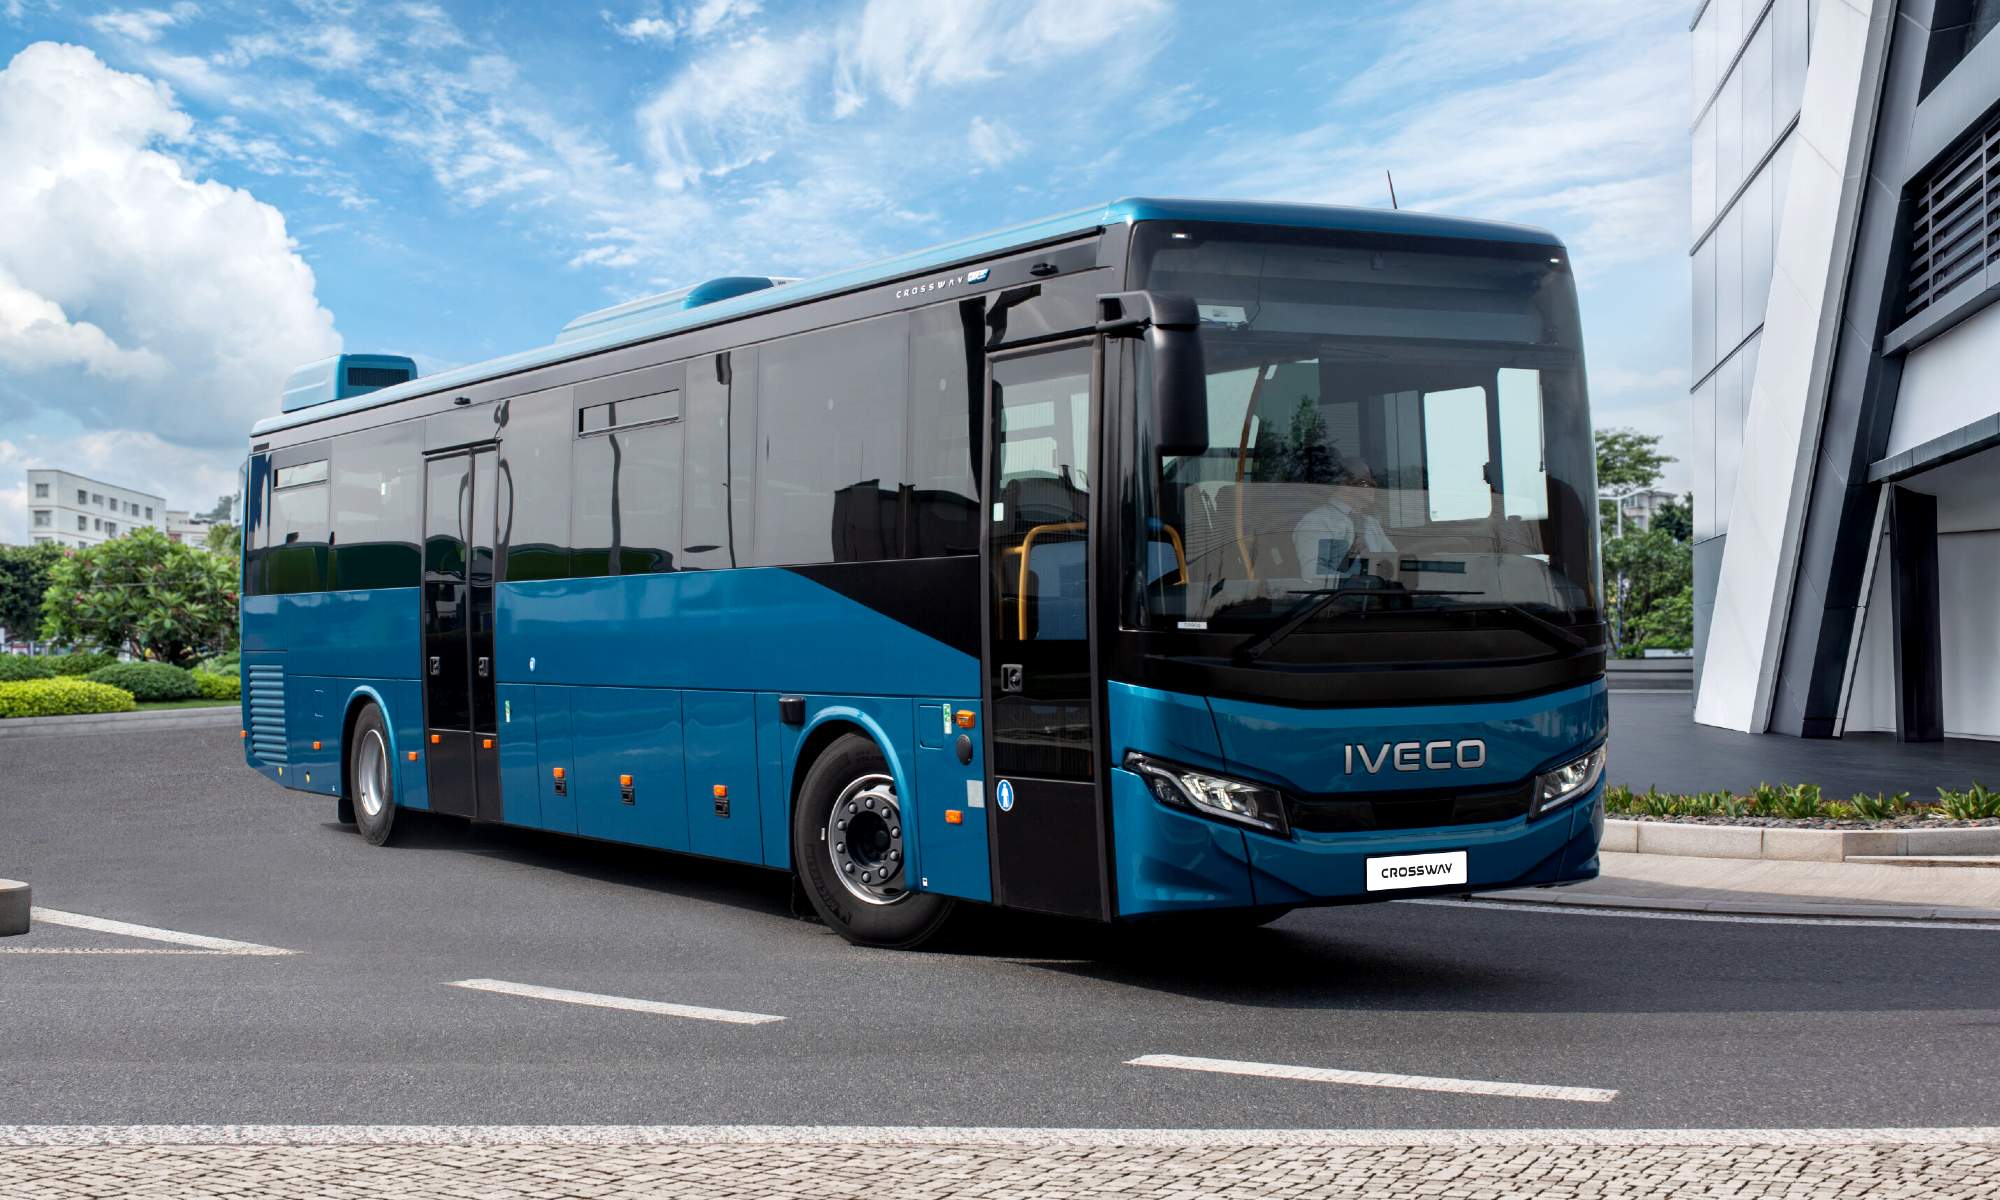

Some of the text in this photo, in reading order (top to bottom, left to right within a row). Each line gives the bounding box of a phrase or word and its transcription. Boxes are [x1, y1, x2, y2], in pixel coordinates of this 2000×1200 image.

[896, 276, 963, 298] CROSSWAY
[1344, 739, 1486, 775] IVECO
[1381, 862, 1453, 879] CROSSWAY
